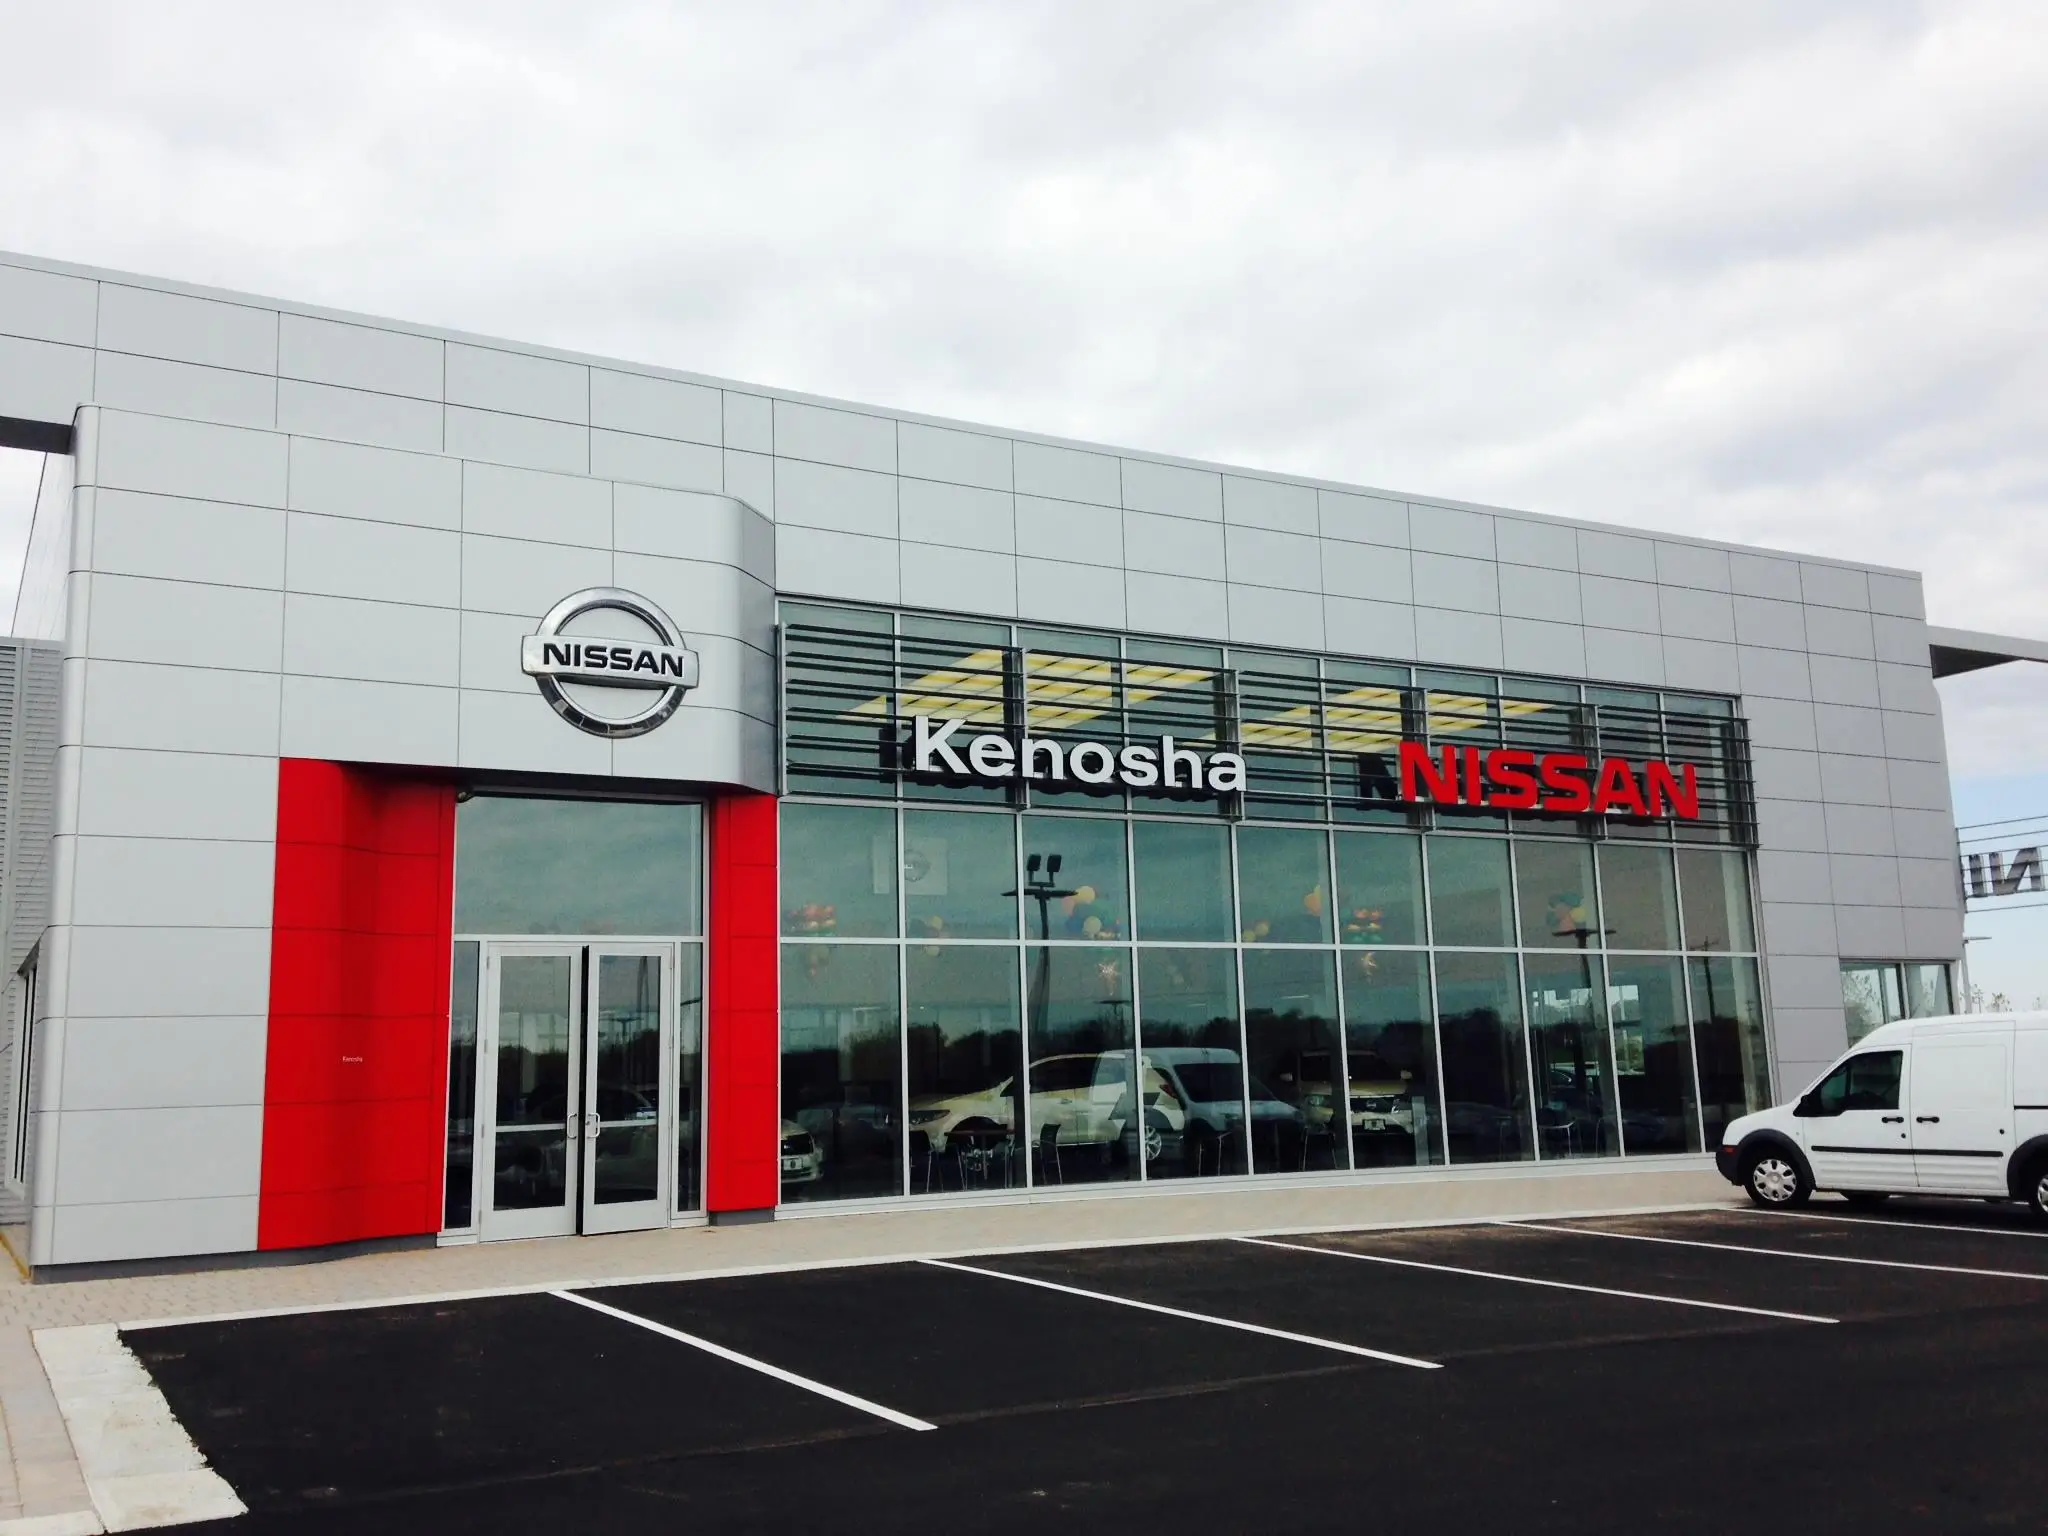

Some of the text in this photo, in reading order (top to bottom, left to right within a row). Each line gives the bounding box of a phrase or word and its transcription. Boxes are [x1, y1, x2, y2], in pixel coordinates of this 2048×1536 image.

[543, 643, 683, 677] NISSAN
[914, 715, 1698, 819] Kenosha NISSAN
